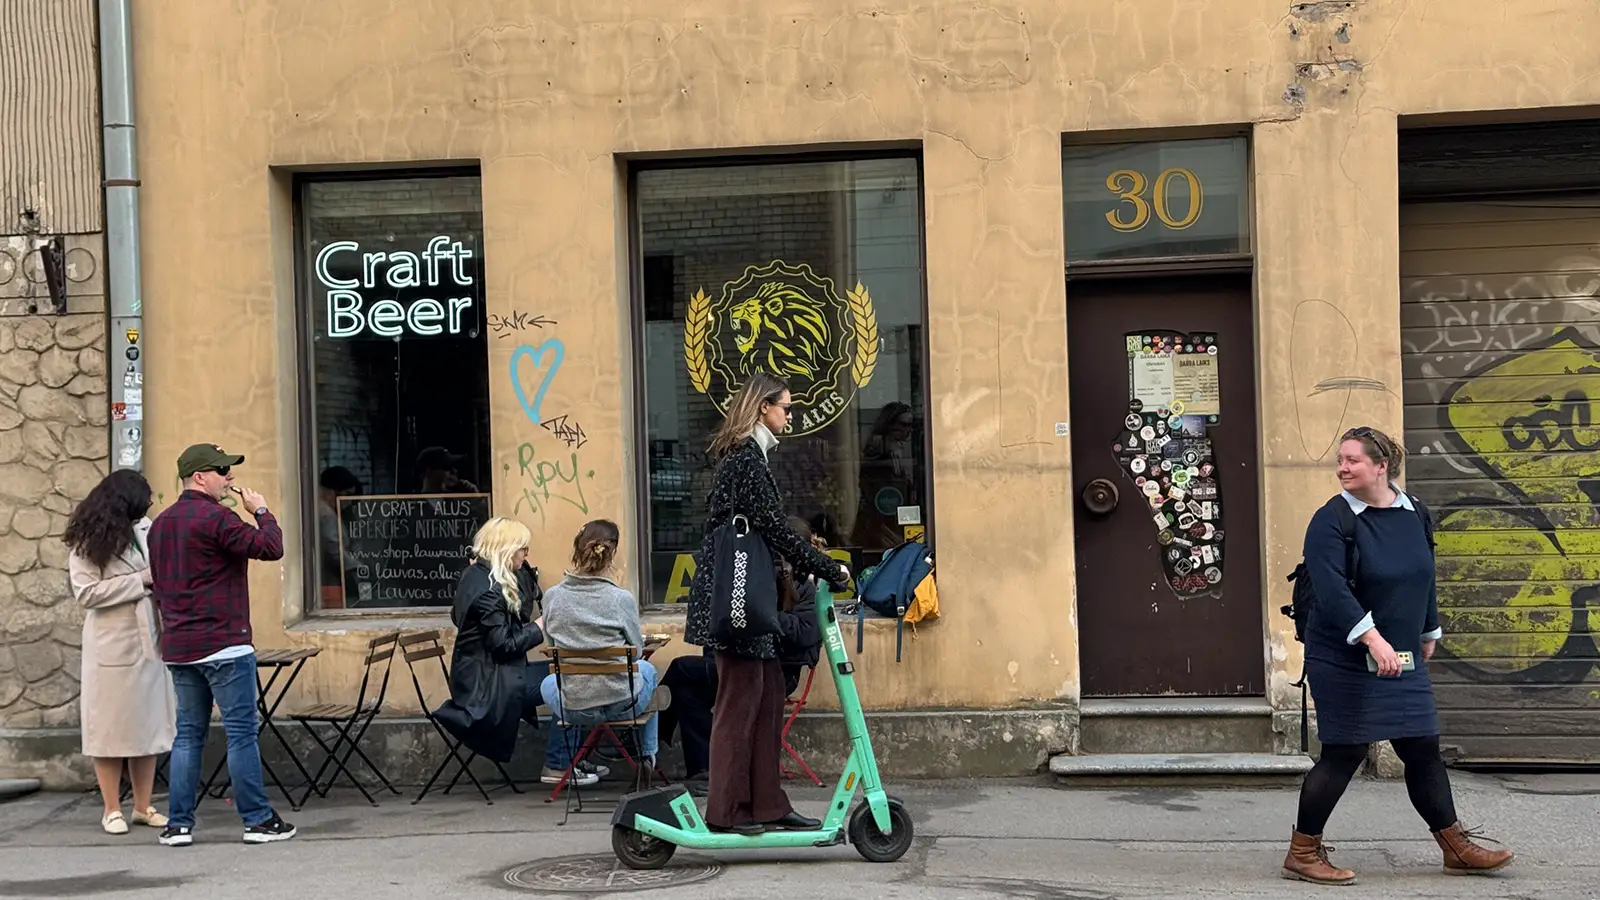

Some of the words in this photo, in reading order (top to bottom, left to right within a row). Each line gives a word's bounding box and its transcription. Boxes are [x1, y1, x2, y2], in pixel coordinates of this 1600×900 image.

[1105, 167, 1204, 233] 30
[315, 235, 473, 289] Craft
[327, 289, 472, 337] Beer
[802, 391, 845, 430] ALUS
[357, 501, 377, 518] LV
[380, 500, 427, 518] CRAFT
[434, 500, 471, 517] ALUS
[377, 582, 432, 600] Lauvas
[826, 625, 842, 651] Bolt
